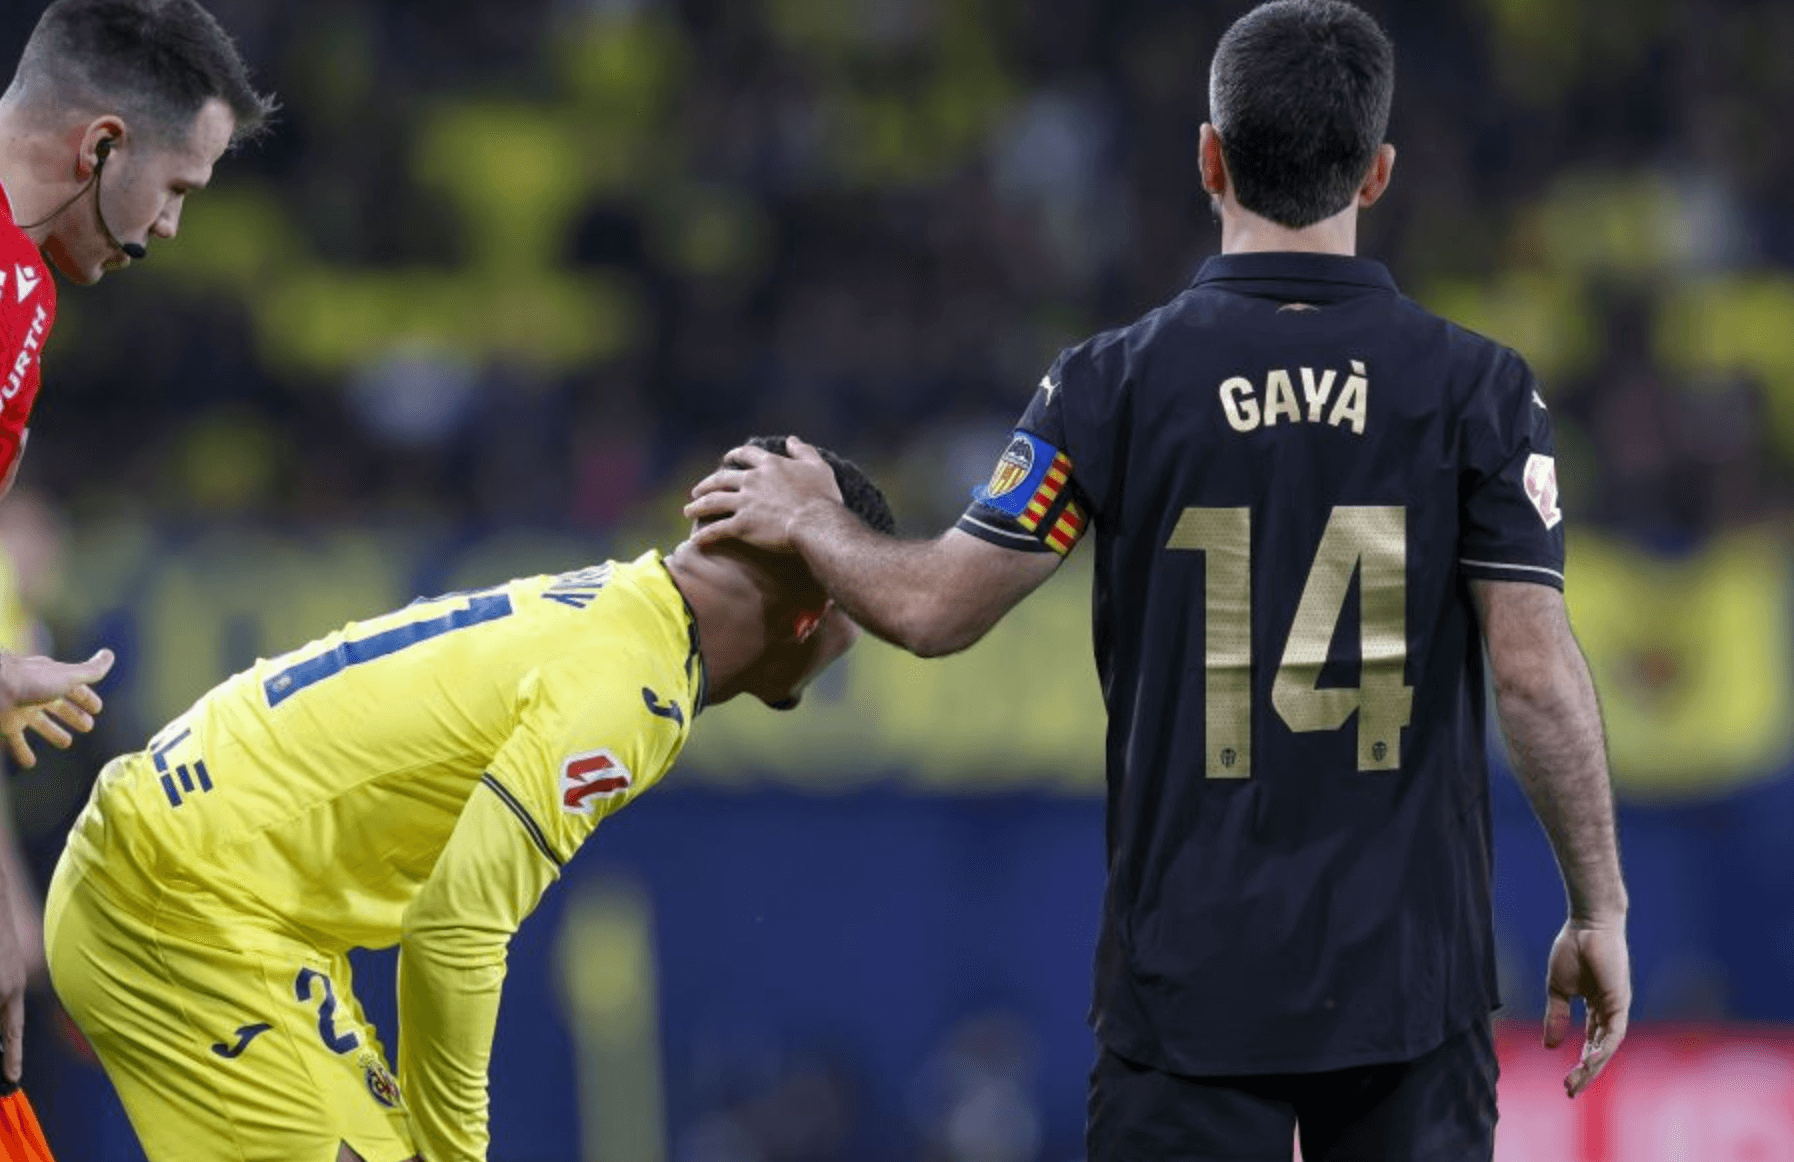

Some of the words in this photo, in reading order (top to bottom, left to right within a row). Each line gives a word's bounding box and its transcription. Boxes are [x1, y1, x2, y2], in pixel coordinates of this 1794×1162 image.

[0, 304, 47, 414] URTH
[1218, 360, 1369, 435] GAYÀ
[264, 588, 512, 708] 1
[1166, 506, 1413, 780] 14
[151, 727, 214, 808] LE
